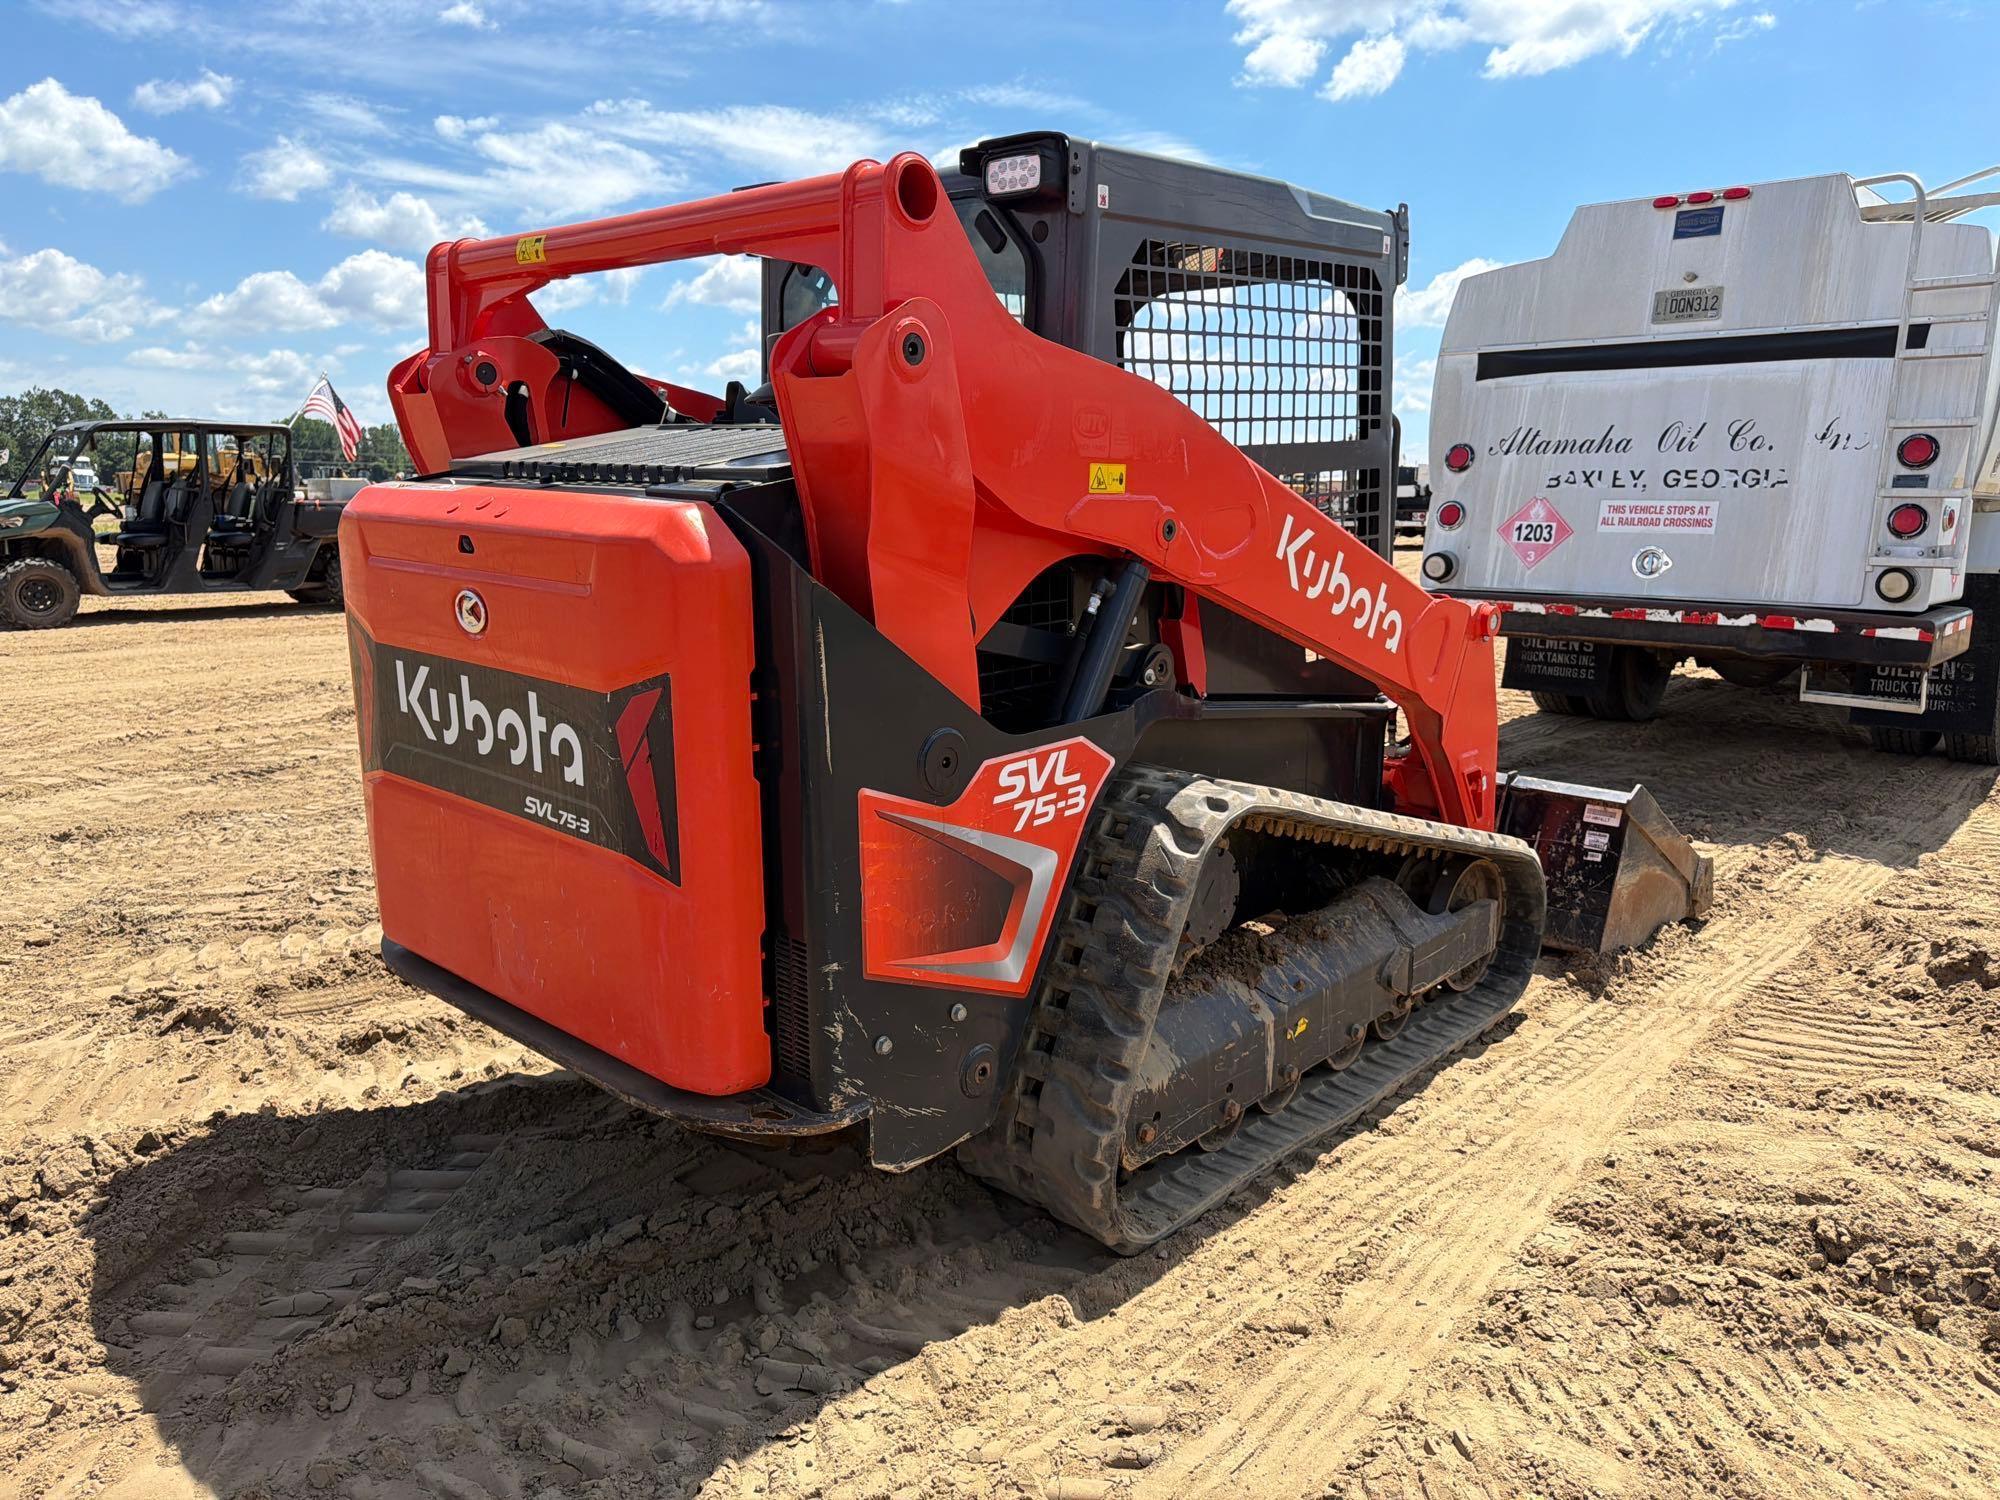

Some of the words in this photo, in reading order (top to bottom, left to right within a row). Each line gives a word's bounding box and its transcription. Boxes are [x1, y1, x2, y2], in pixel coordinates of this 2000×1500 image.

[1671, 288, 1707, 298] GEORGIA
[1669, 295, 1719, 314] DQN312
[1488, 424, 1634, 456] Altamaha
[1657, 420, 1708, 453] Oil
[1727, 418, 1774, 452] Co.
[1607, 504, 1627, 515] THIS
[1628, 505, 1665, 516] VEHICLE
[1666, 505, 1696, 516] STOPS
[1697, 506, 1711, 516] AT
[1600, 516, 1616, 527] ALL
[1617, 516, 1661, 527] RAILROAD
[1662, 517, 1713, 528] CROSSINGS
[1514, 523, 1553, 542] 1203
[1526, 550, 1536, 561] 3
[1275, 513, 1403, 655] Kubota
[1546, 651, 1577, 665] TANKS
[1869, 678, 1908, 694] TRUCK
[1911, 681, 1952, 696] TNKS
[395, 659, 585, 787] Kubota
[993, 749, 1081, 805] SVL
[1013, 784, 1087, 833] 75-3
